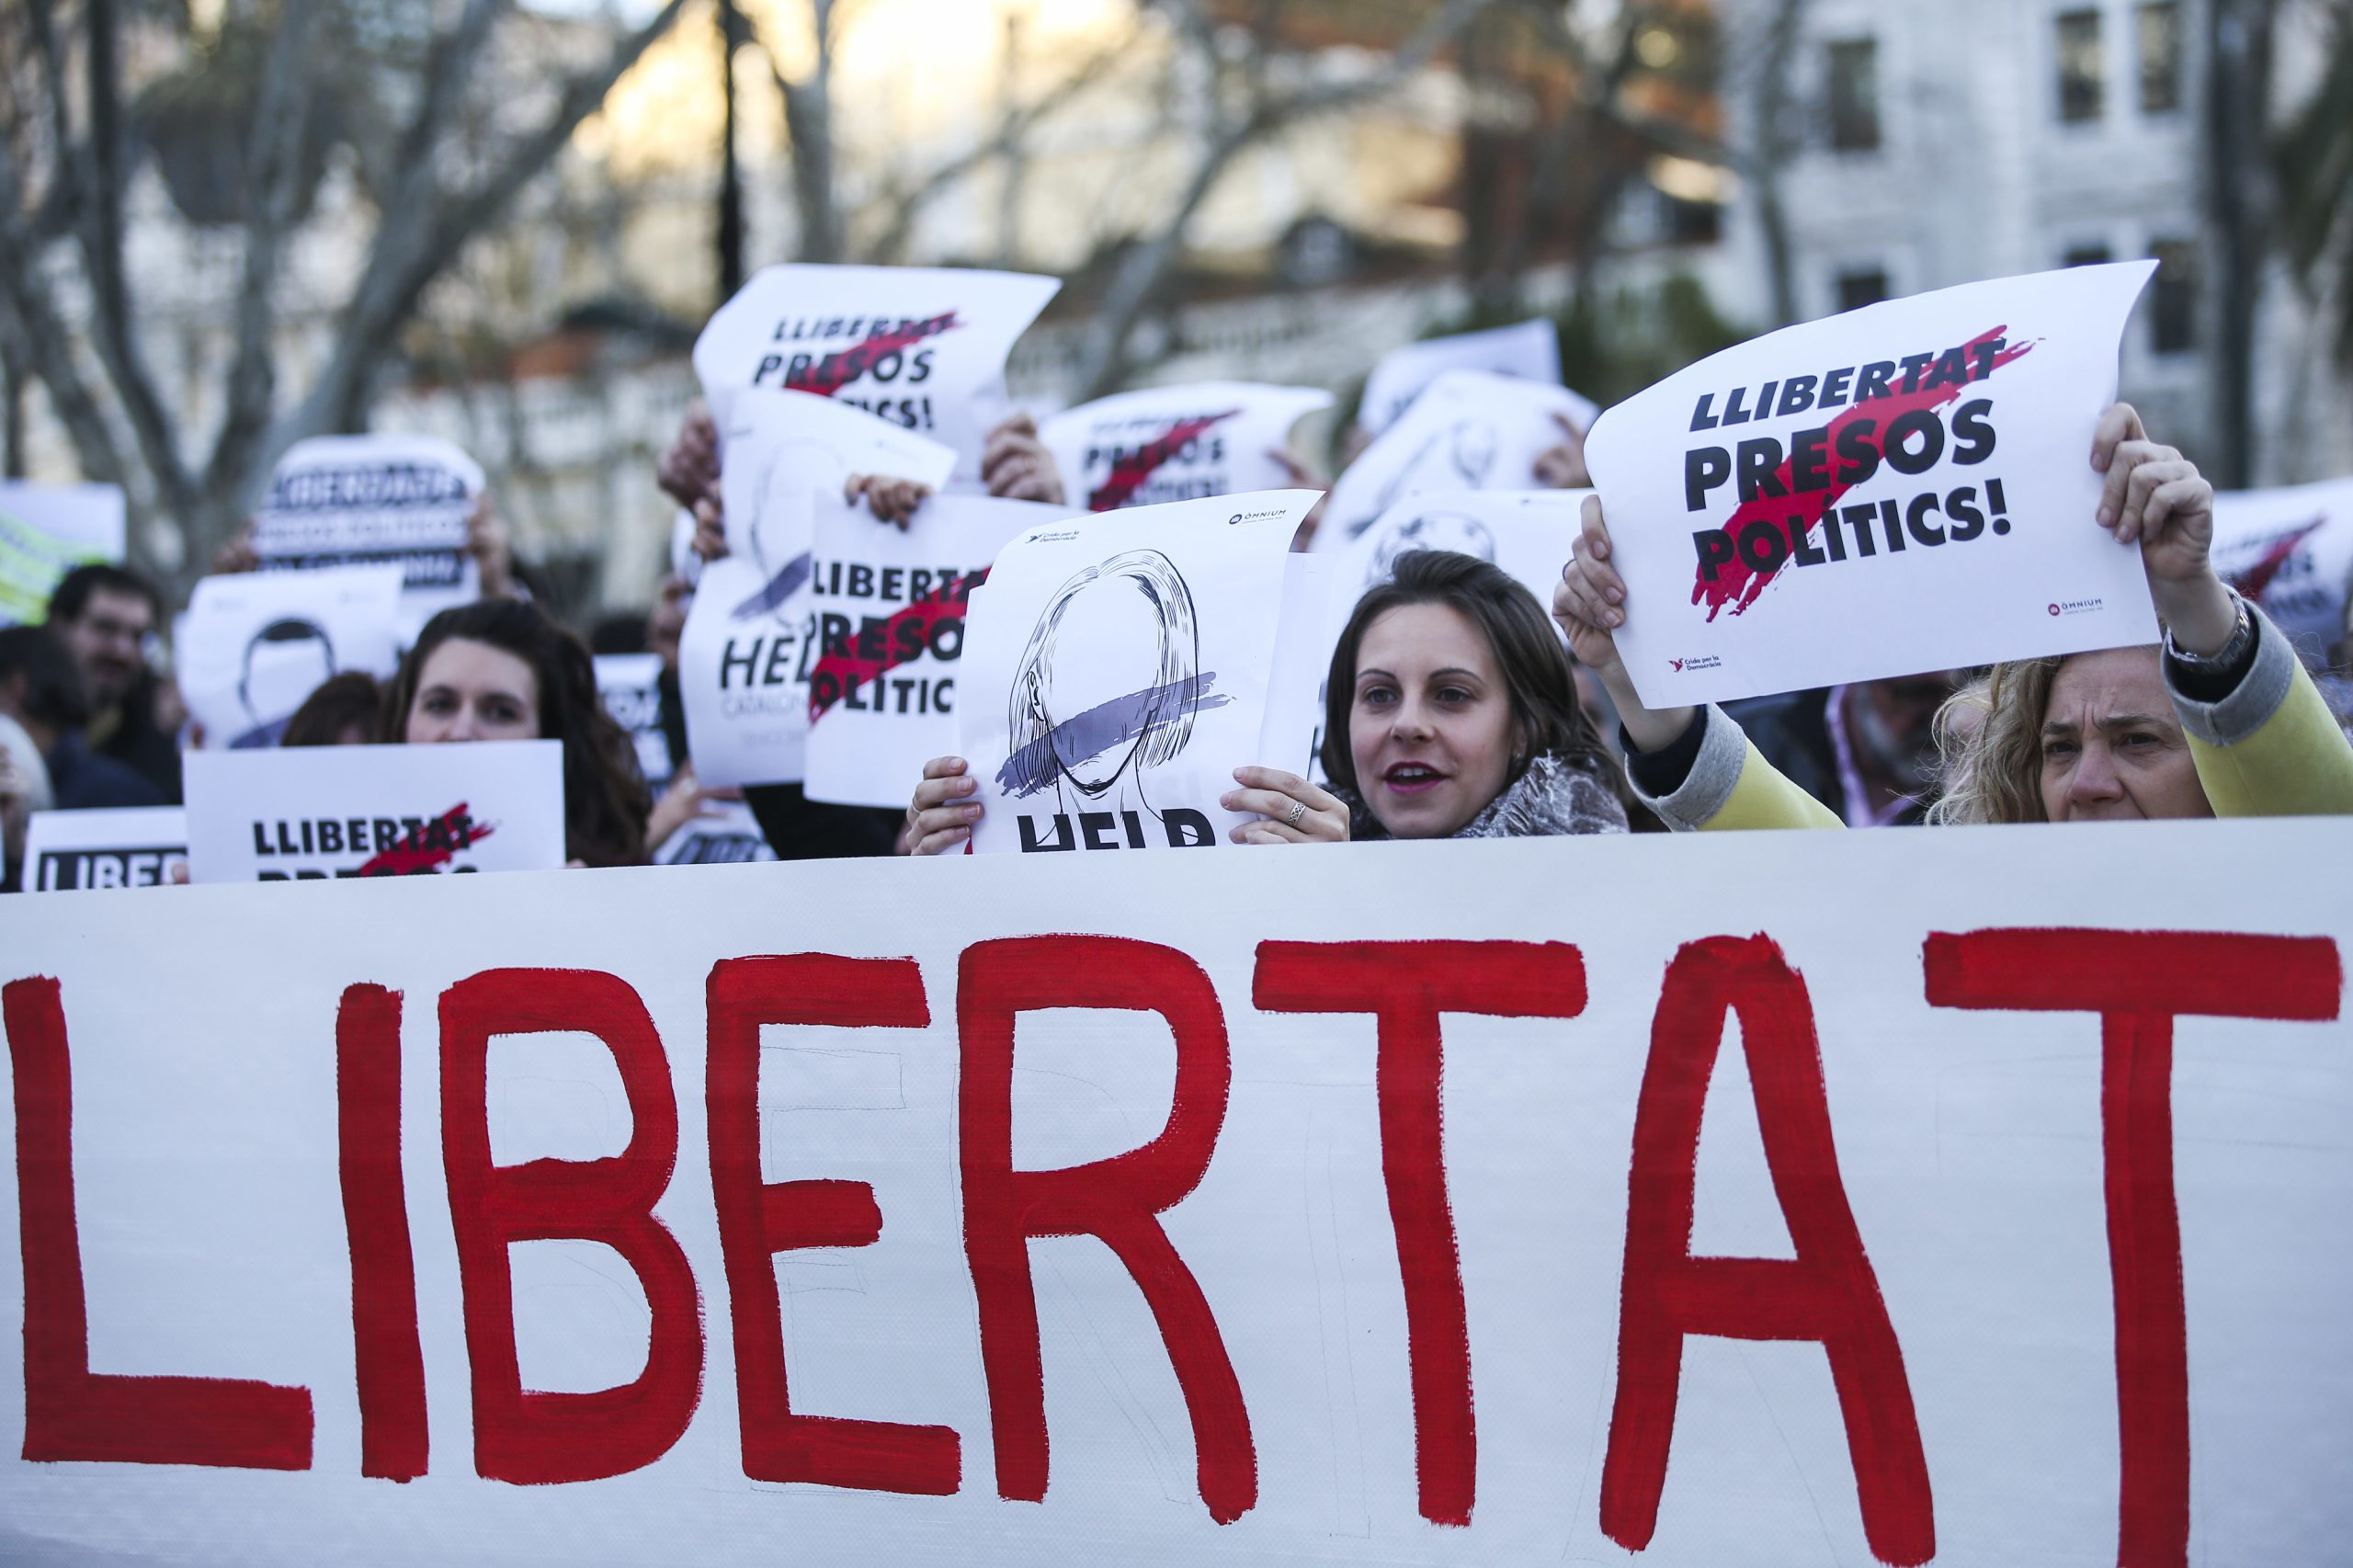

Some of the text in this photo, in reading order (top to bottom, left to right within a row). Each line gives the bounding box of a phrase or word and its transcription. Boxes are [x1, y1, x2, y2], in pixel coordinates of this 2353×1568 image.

[753, 348, 936, 387] PRESOS
[1689, 337, 2007, 433] LLIBERTAT
[1685, 398, 1996, 513] PRESOS
[1692, 478, 2011, 582] POLÍTICS!
[813, 561, 992, 604] LIBERTA
[721, 634, 812, 691] HEL
[806, 612, 966, 663] RESO
[1684, 657, 1700, 665] Crida
[252, 814, 474, 857] LLIBERTAT
[2, 926, 2344, 1568] LIBERTAT
